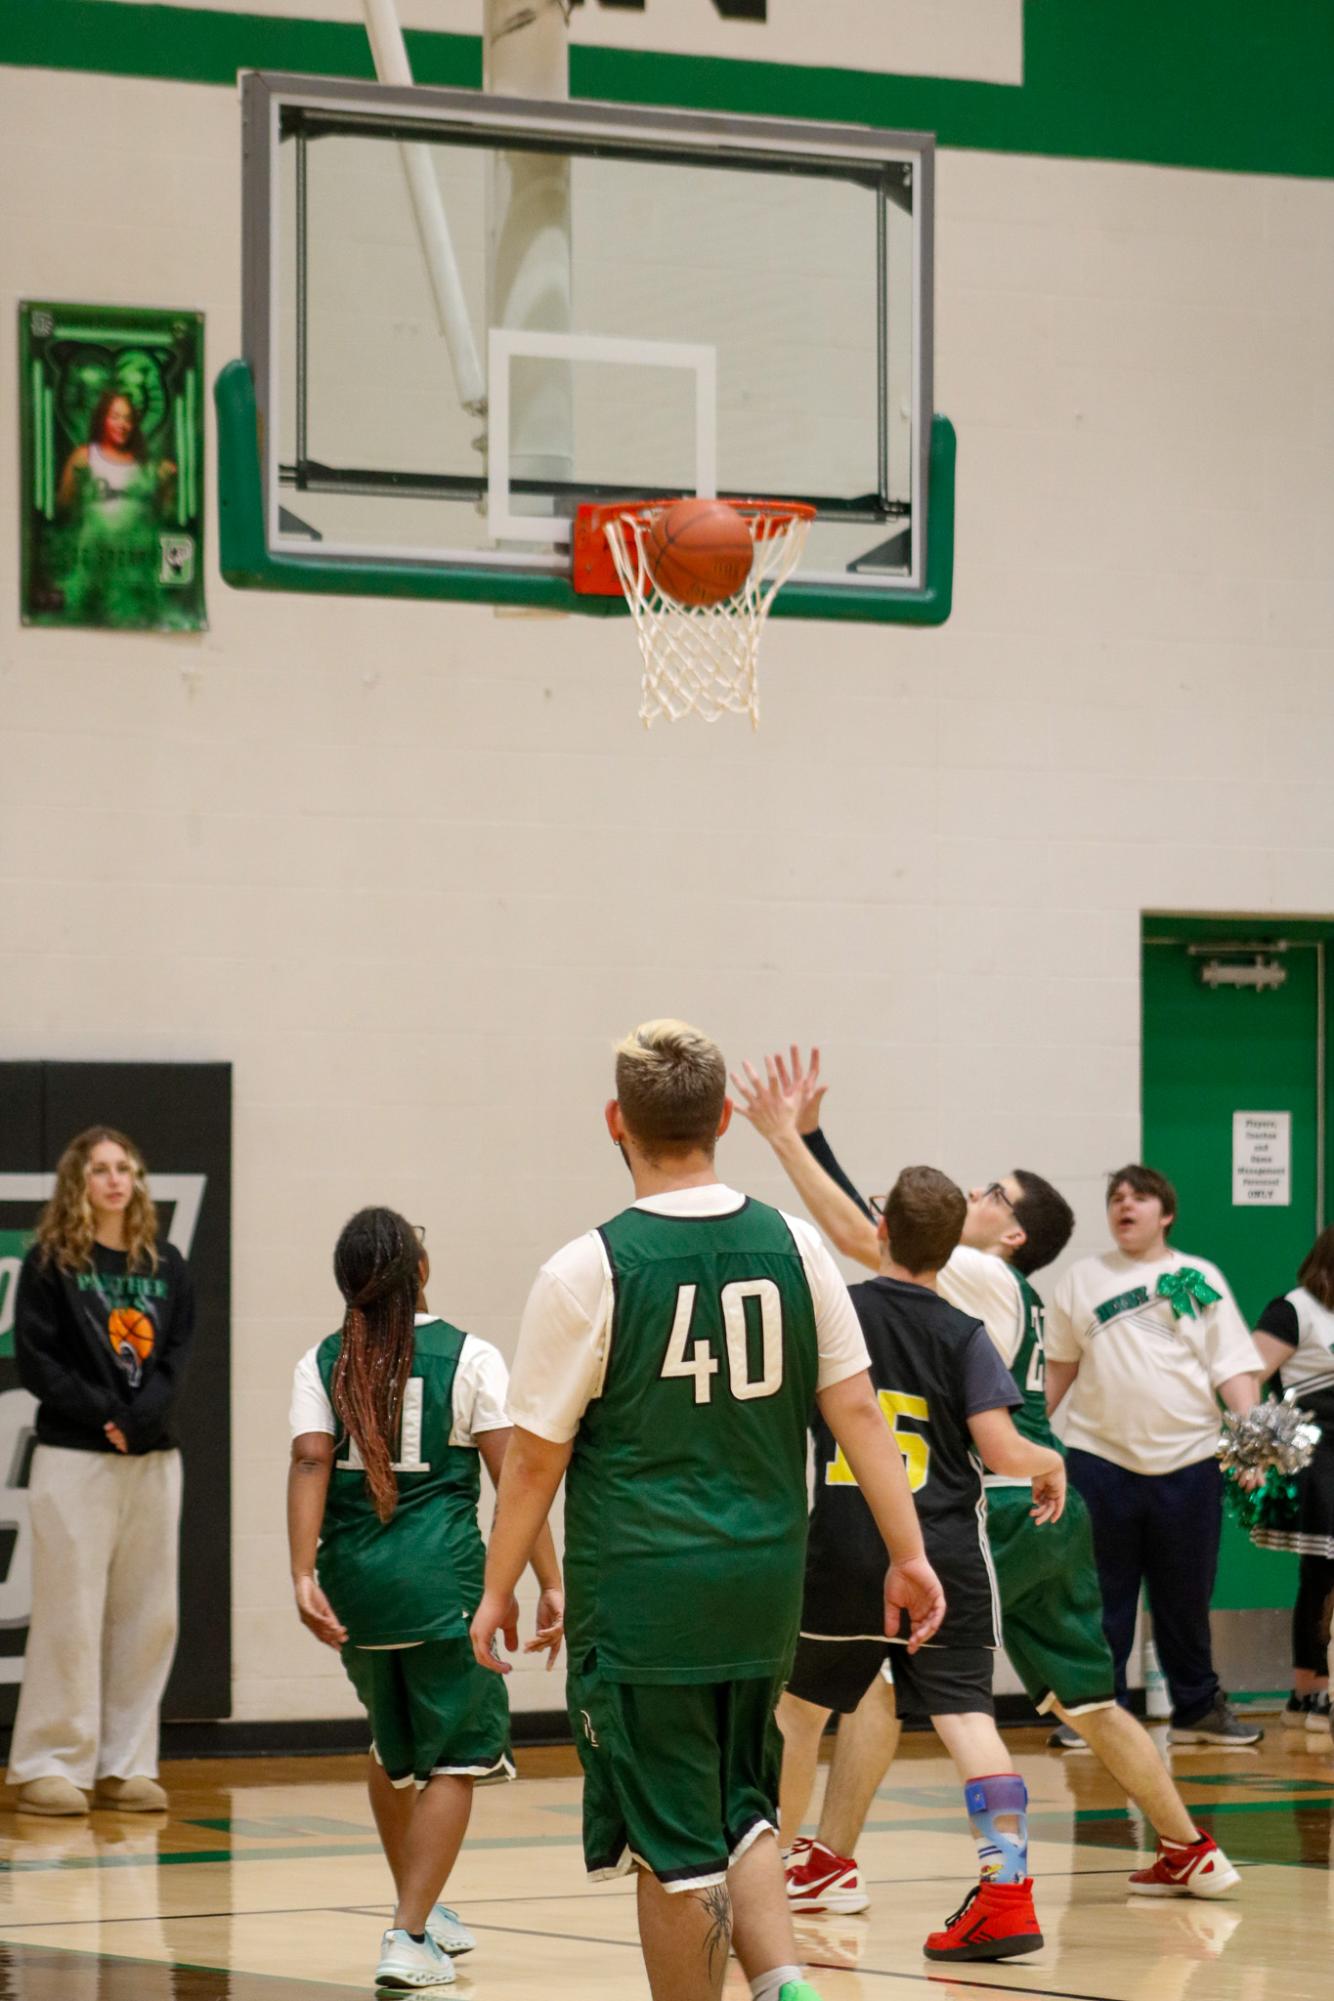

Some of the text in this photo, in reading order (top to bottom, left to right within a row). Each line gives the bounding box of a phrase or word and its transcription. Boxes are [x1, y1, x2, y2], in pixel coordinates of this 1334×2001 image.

[1247, 1190, 1274, 1200] ONLY
[659, 1278, 784, 1405] 40
[1025, 1304, 1047, 1393] 2
